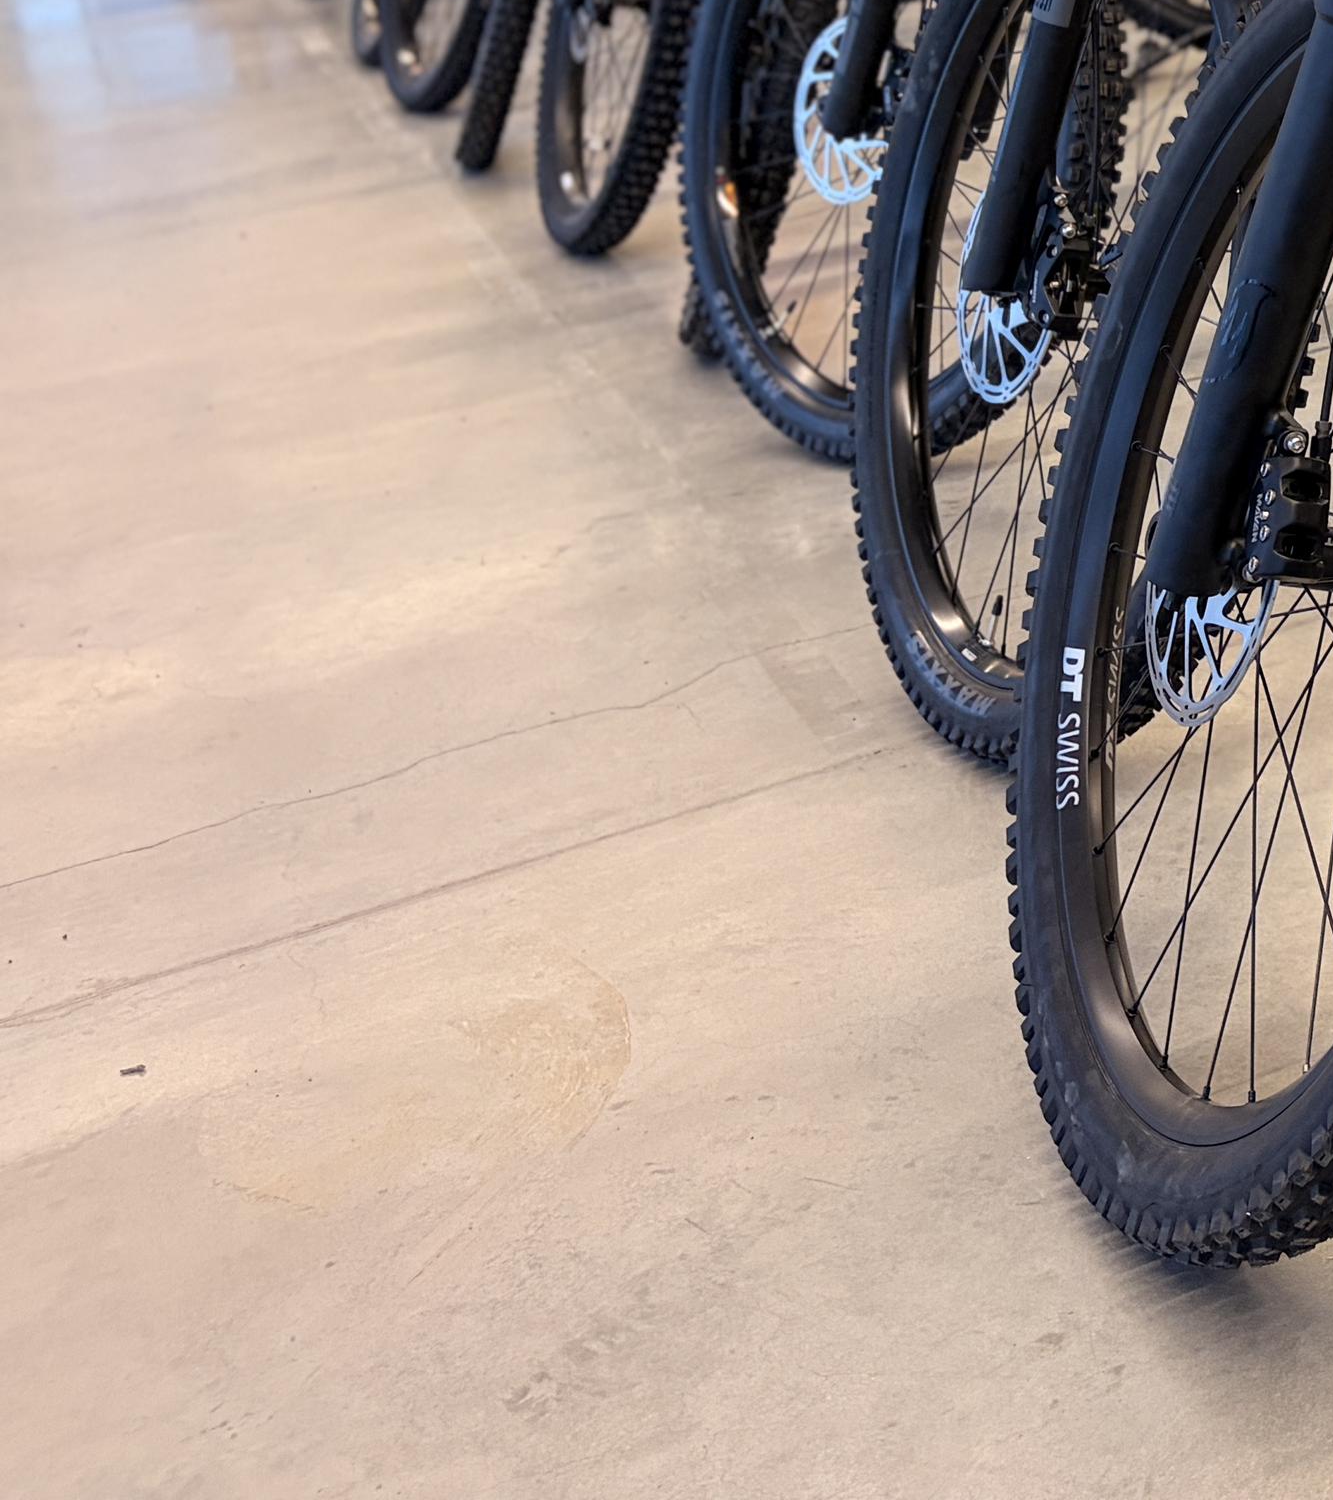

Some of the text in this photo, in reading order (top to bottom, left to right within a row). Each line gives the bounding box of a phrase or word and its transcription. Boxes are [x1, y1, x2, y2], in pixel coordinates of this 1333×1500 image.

[906, 630, 997, 717] MAXXIS
[1055, 647, 1086, 810] DT SWISS
